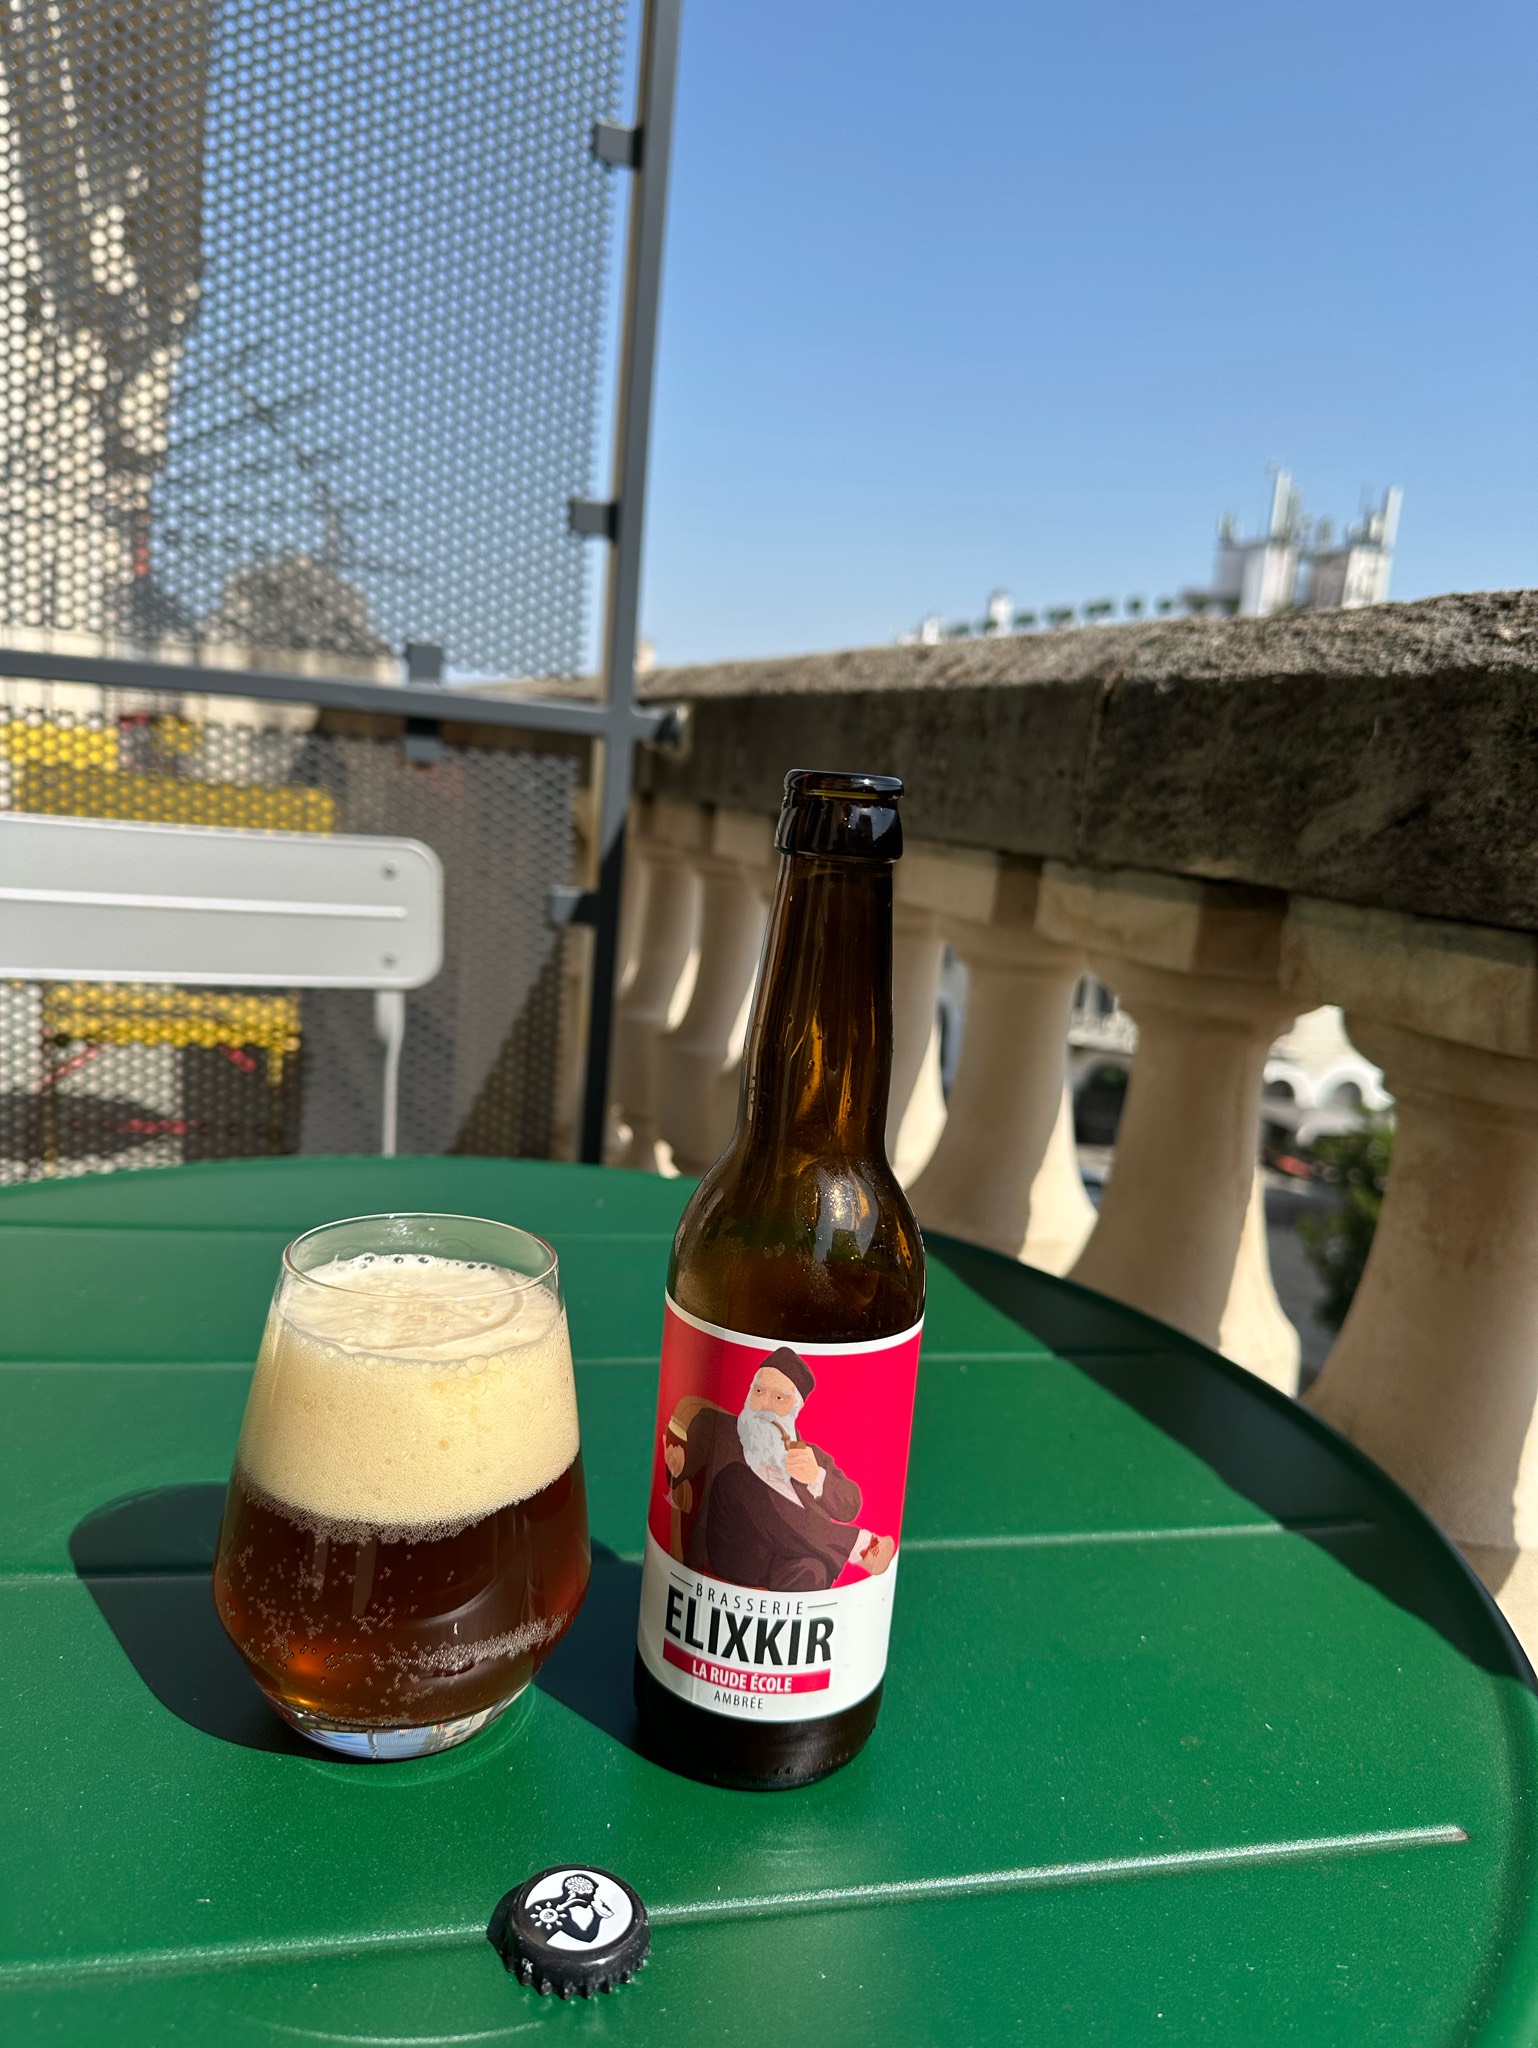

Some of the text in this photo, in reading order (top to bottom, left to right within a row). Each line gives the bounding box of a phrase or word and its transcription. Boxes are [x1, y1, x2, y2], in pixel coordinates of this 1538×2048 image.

[696, 1583, 803, 1615] BRASSERIE
[665, 1584, 834, 1666] ELIXKIR
[692, 1659, 793, 1693] LA RUDE ÉCOLE
[714, 1690, 764, 1710] AMBRÉE
